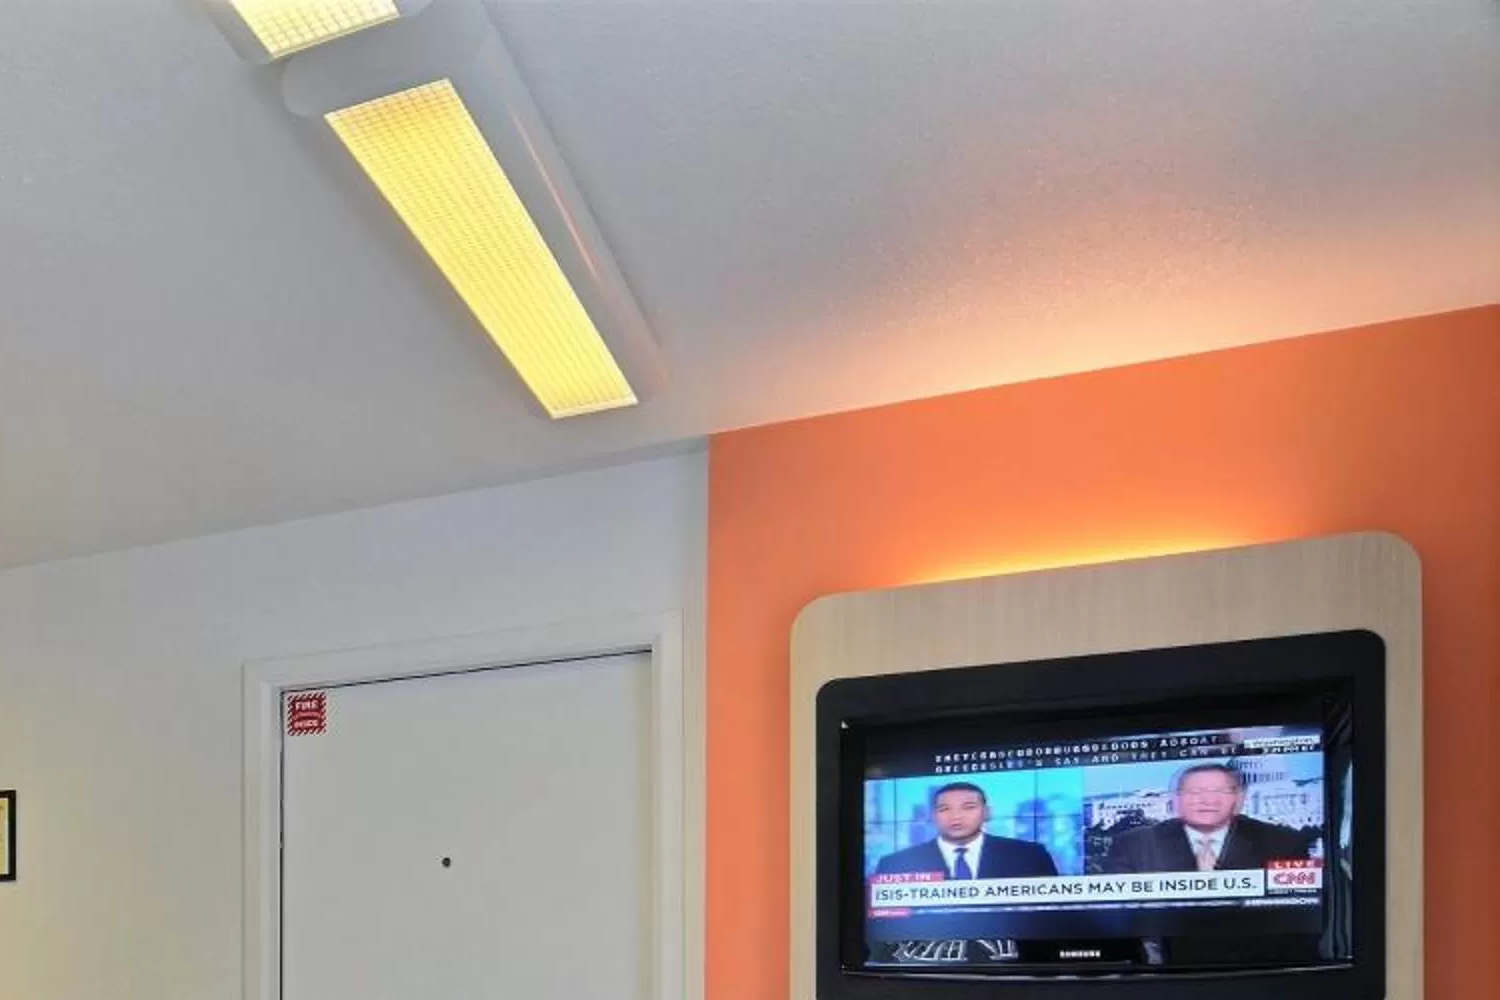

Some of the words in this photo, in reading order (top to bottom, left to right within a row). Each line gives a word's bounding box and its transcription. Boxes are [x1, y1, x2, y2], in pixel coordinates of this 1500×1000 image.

[1273, 871, 1316, 885] CNN
[875, 885, 980, 901] ISIS-TRAINED
[984, 883, 1083, 899] AMERICANS
[1088, 881, 1126, 894] MAY
[1131, 880, 1153, 893] BE
[1159, 877, 1219, 892] INSIDE
[1223, 877, 1258, 890] U.S.
